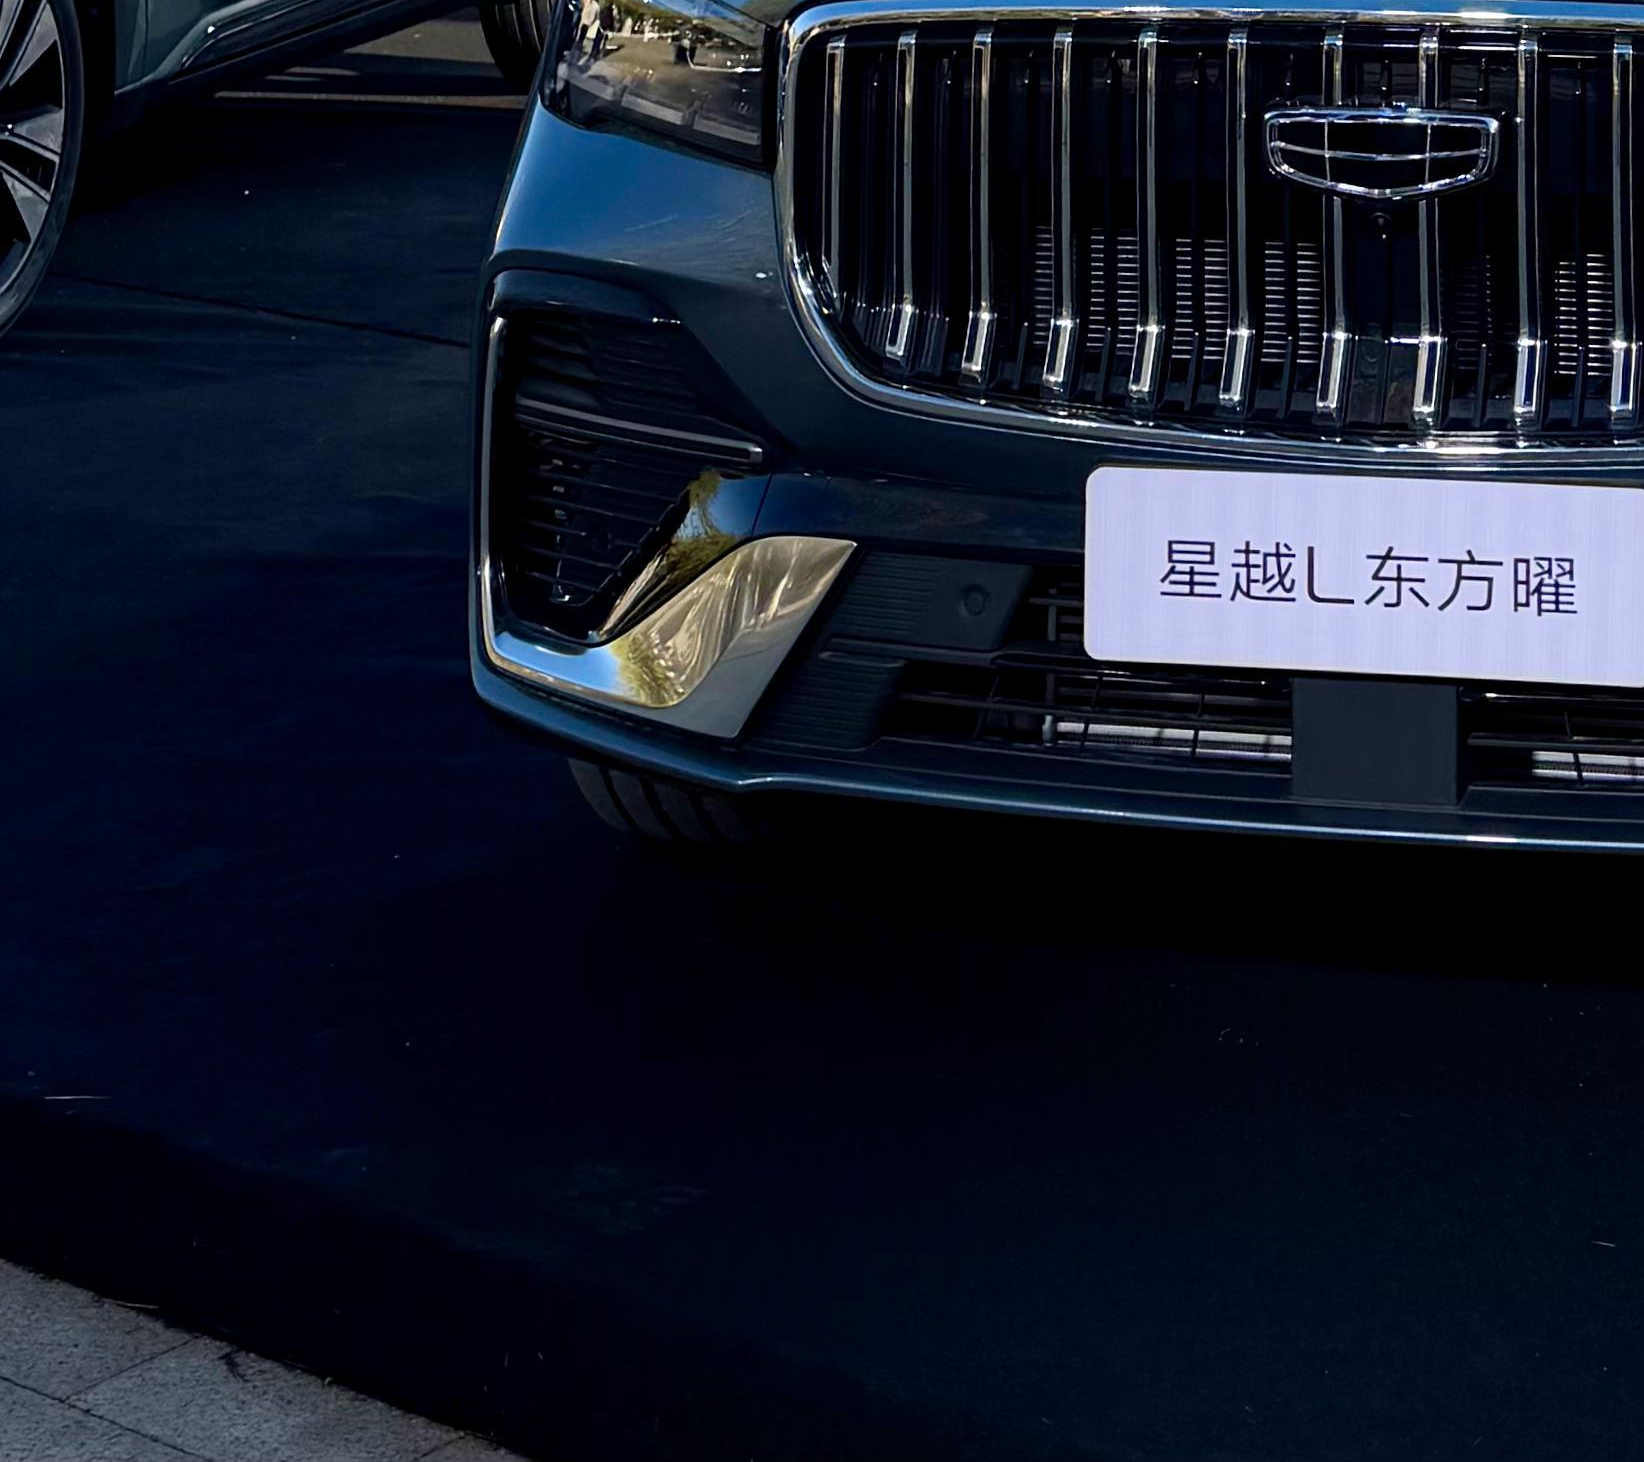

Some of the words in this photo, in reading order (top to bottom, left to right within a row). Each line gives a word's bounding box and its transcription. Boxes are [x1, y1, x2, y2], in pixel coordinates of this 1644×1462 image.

[1159, 539, 1579, 617] 星越L东方曜
